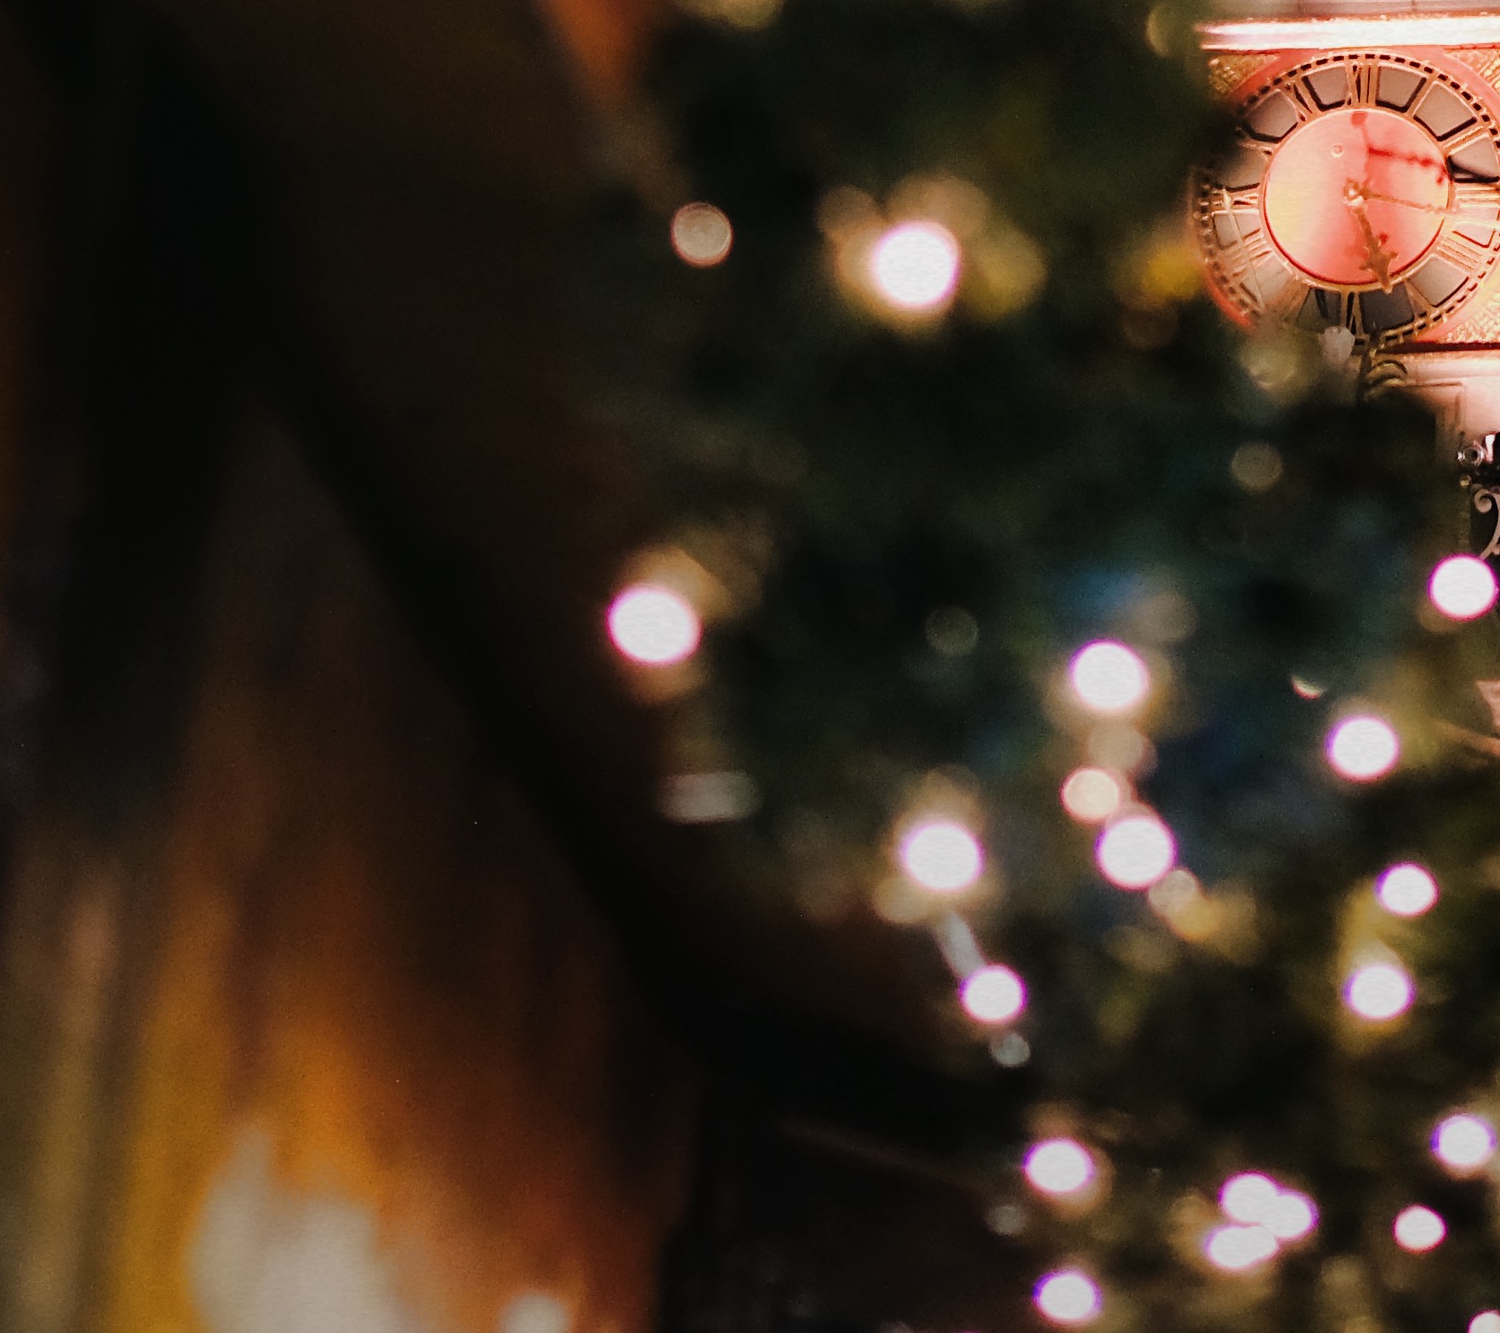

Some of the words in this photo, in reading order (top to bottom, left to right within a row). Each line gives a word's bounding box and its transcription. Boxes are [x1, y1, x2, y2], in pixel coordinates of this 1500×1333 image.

[1286, 77, 1322, 121] XI
[1346, 62, 1379, 107] XII
[1406, 75, 1435, 118] I
[1441, 119, 1490, 157] II
